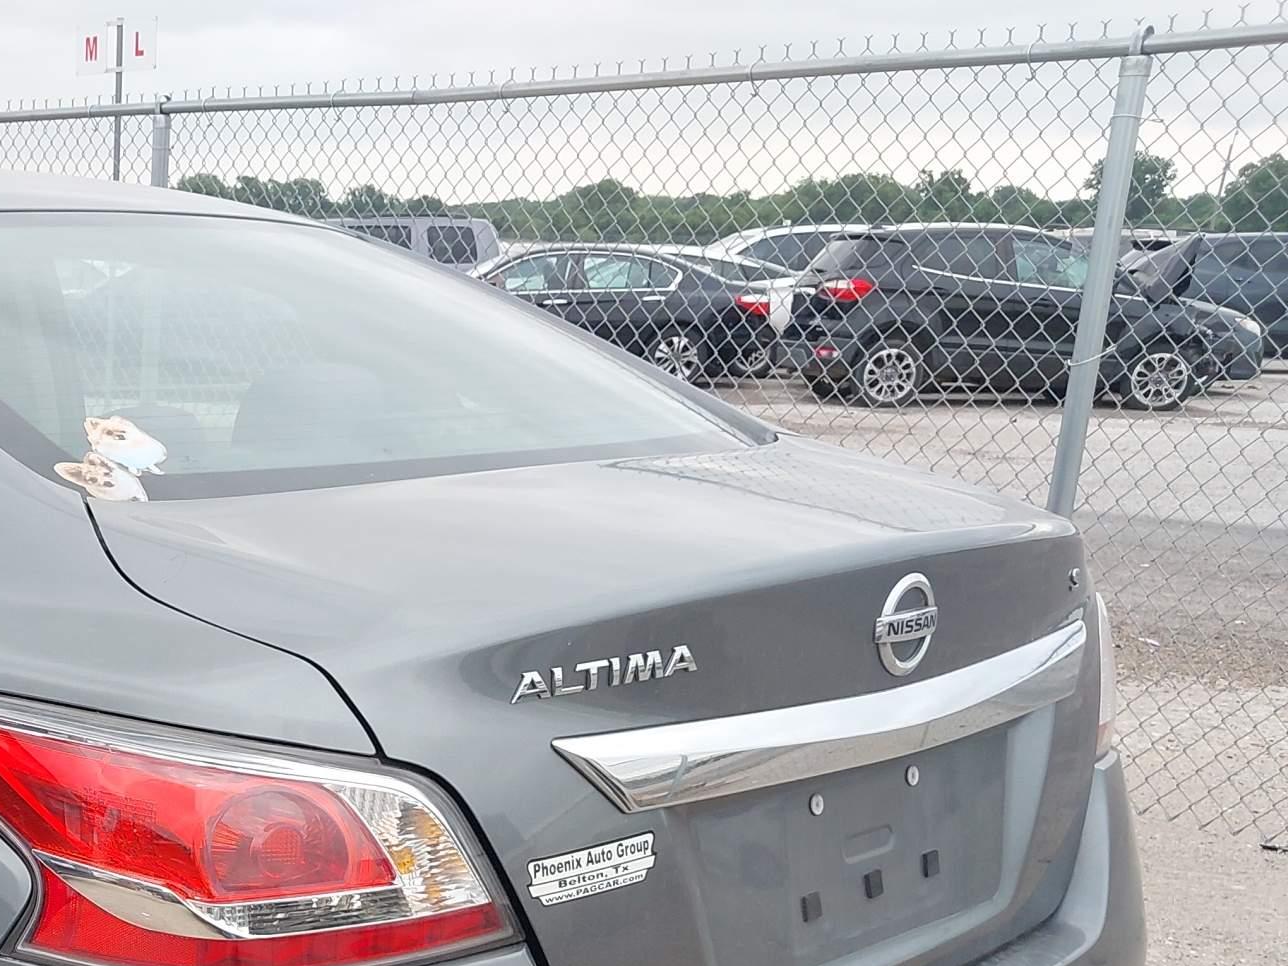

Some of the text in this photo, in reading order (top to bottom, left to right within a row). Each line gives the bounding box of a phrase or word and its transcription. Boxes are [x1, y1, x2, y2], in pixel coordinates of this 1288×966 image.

[85, 35, 98, 62] M
[135, 31, 144, 56] L
[887, 614, 937, 637] NISSAN
[510, 644, 698, 704] ALTIMA
[533, 839, 649, 879] Phoenix Auto Group
[545, 873, 644, 903] www.PAGCAR.com
